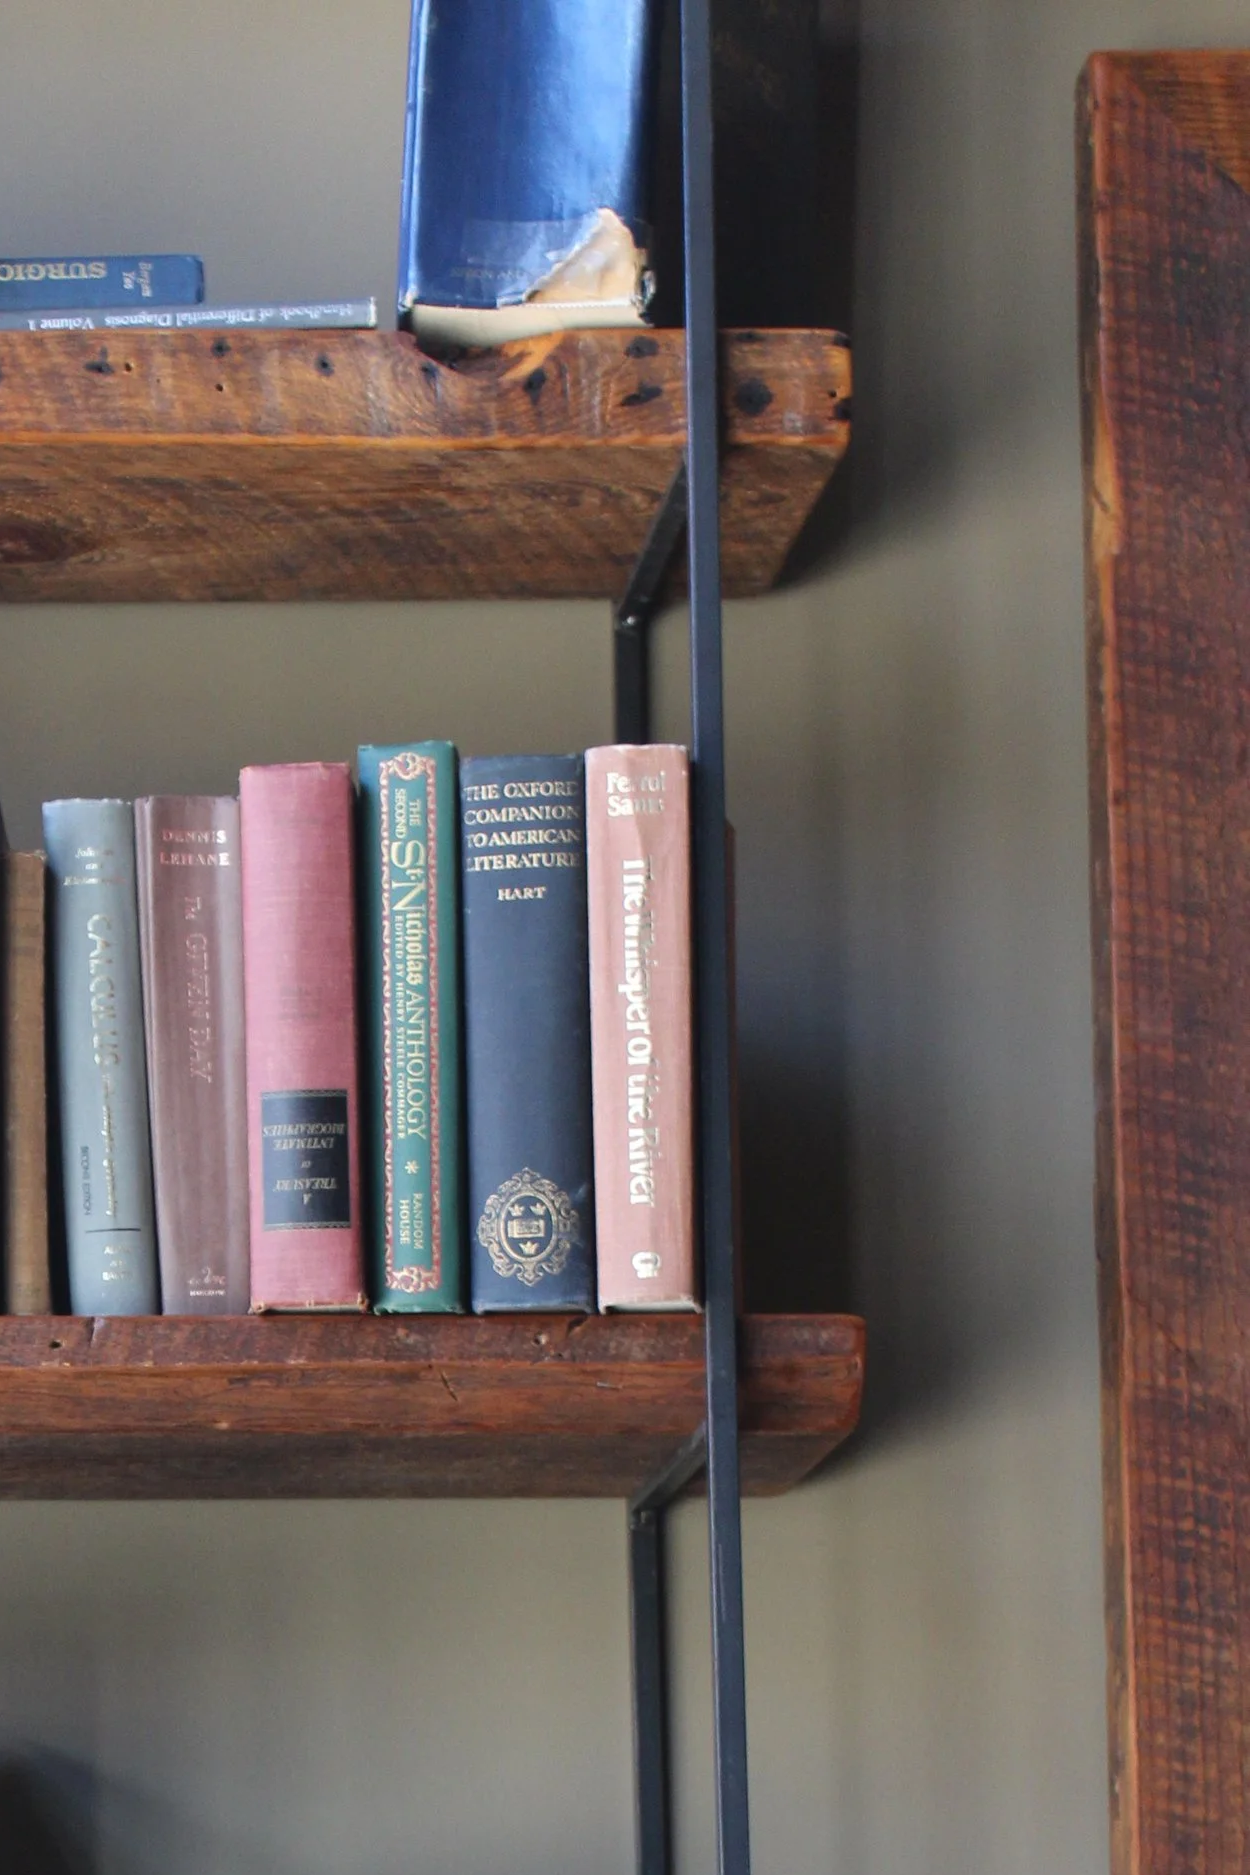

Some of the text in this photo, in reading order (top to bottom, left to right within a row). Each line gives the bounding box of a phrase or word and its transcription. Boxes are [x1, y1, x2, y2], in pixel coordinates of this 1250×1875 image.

[40, 317, 96, 331] Volume
[105, 311, 172, 328] Diagnosis
[176, 309, 257, 327] Differential
[258, 308, 274, 322] of
[463, 780, 578, 801] THE OXFORD
[394, 788, 409, 840] SECOND
[408, 798, 422, 827] THE
[463, 805, 580, 825] COMPANION
[161, 829, 227, 844] DENNIS
[466, 828, 581, 849] TO AMERICAN
[159, 851, 230, 867] LEHANE
[466, 851, 581, 872] LITERATURE
[497, 885, 547, 901] HART
[623, 855, 654, 912] The
[394, 915, 408, 1140] EDITED BY HENRY STEELE COMMAGER
[188, 1027, 212, 1084] DAY
[626, 1036, 660, 1068] of
[407, 988, 428, 1140] ANTHOLOGY
[261, 1123, 345, 1138] BIOGRAPHIES
[272, 1137, 335, 1152] INTIMATE
[629, 1126, 662, 1207] River
[399, 1199, 411, 1245] HOUSE
[413, 1192, 424, 1250] RANDOM
